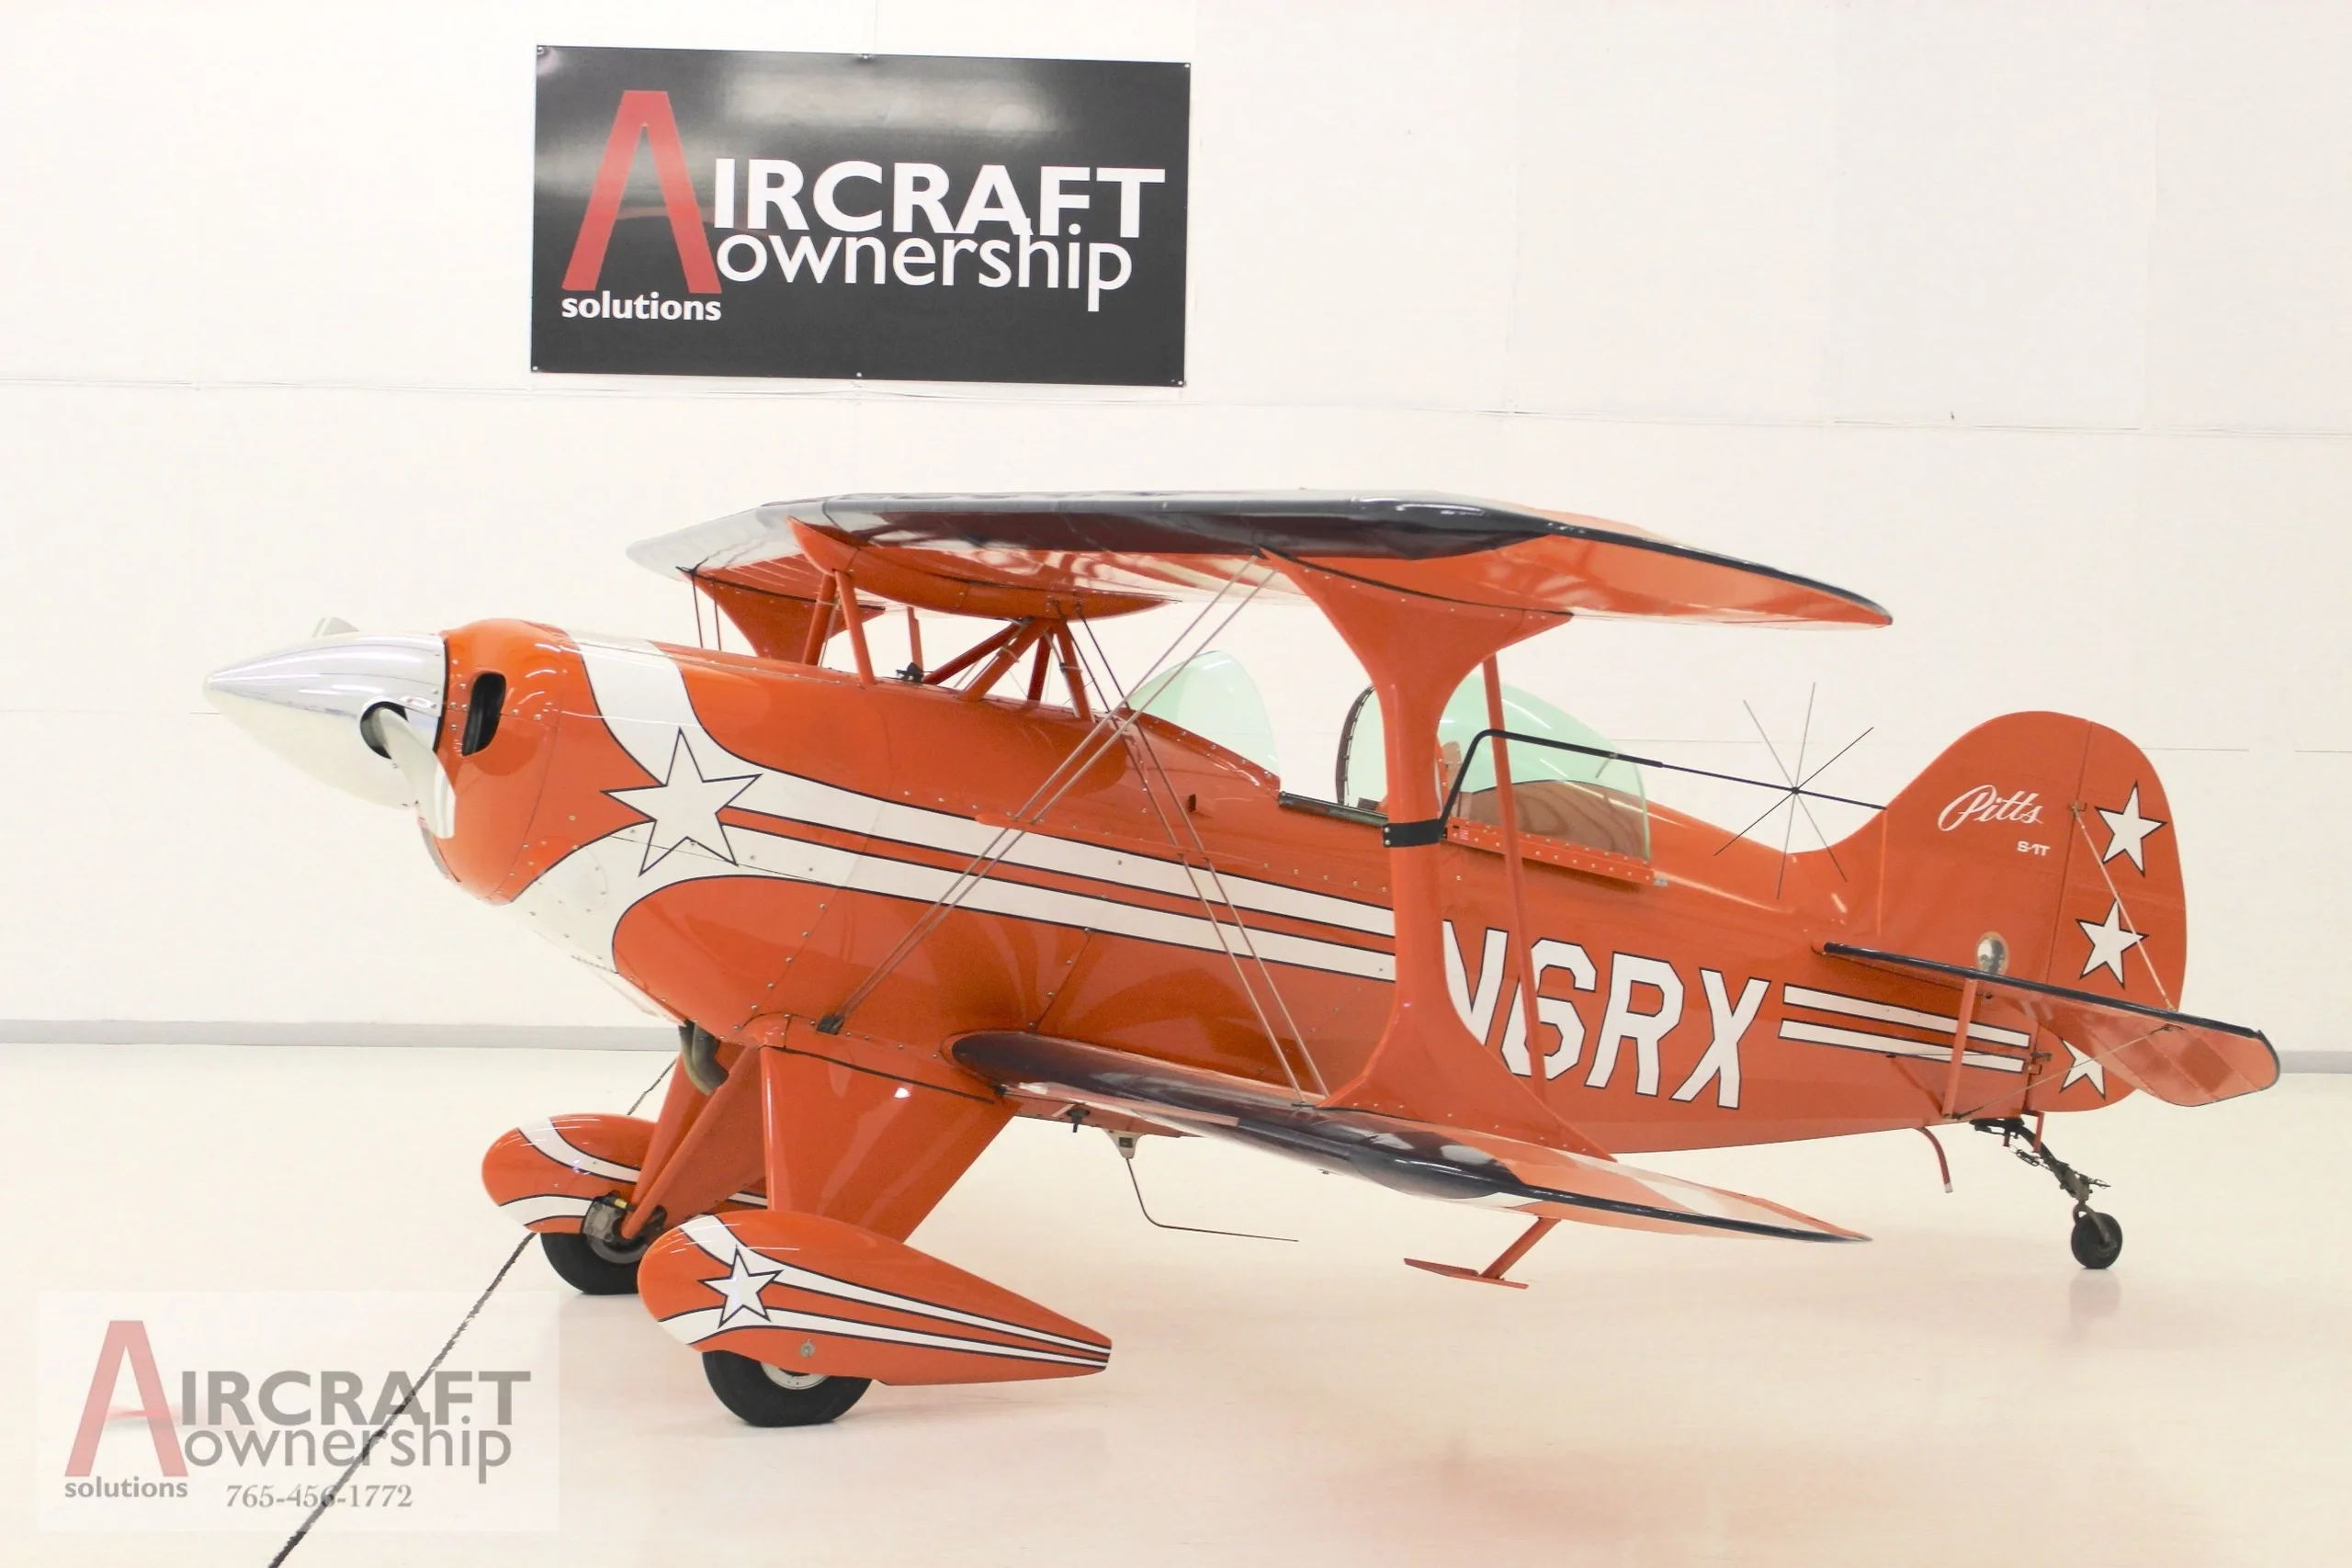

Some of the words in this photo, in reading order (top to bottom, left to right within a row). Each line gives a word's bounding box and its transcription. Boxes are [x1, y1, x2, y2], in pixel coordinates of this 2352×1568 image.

[717, 217, 1133, 312] ownership
[561, 292, 722, 321] solutions
[1938, 784, 2044, 831] Pitts
[2017, 840, 2051, 856] S-1T
